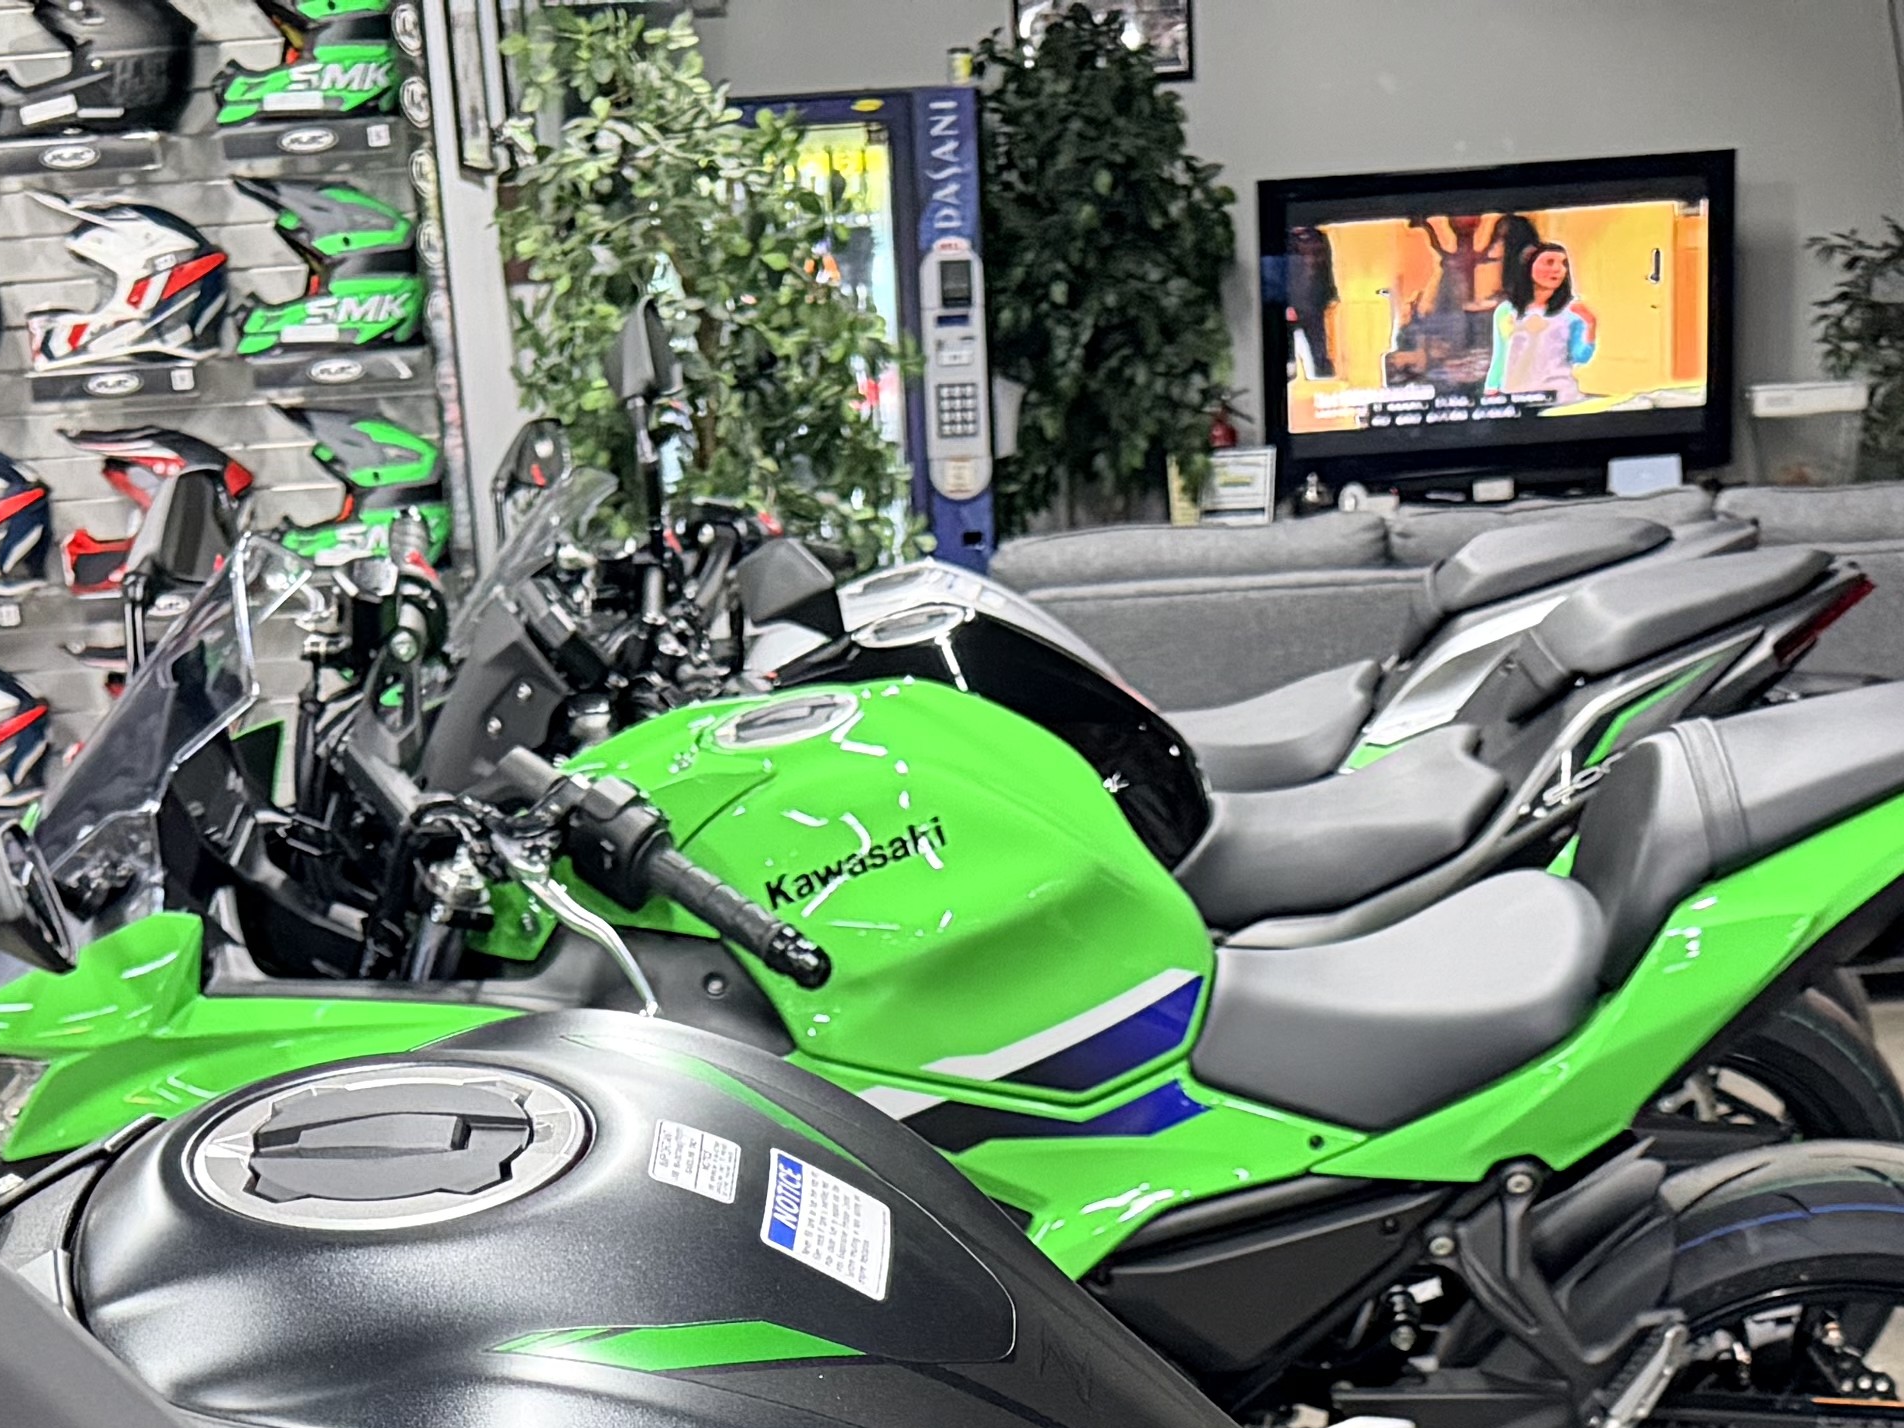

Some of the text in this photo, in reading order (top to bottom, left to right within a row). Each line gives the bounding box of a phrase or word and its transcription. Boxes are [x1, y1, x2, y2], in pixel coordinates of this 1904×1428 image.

[287, 62, 392, 91] SMK
[925, 100, 963, 229] DASANI
[302, 293, 409, 324] SMK
[764, 815, 947, 911] Kawasaki
[773, 1163, 802, 1231] NOTICE
